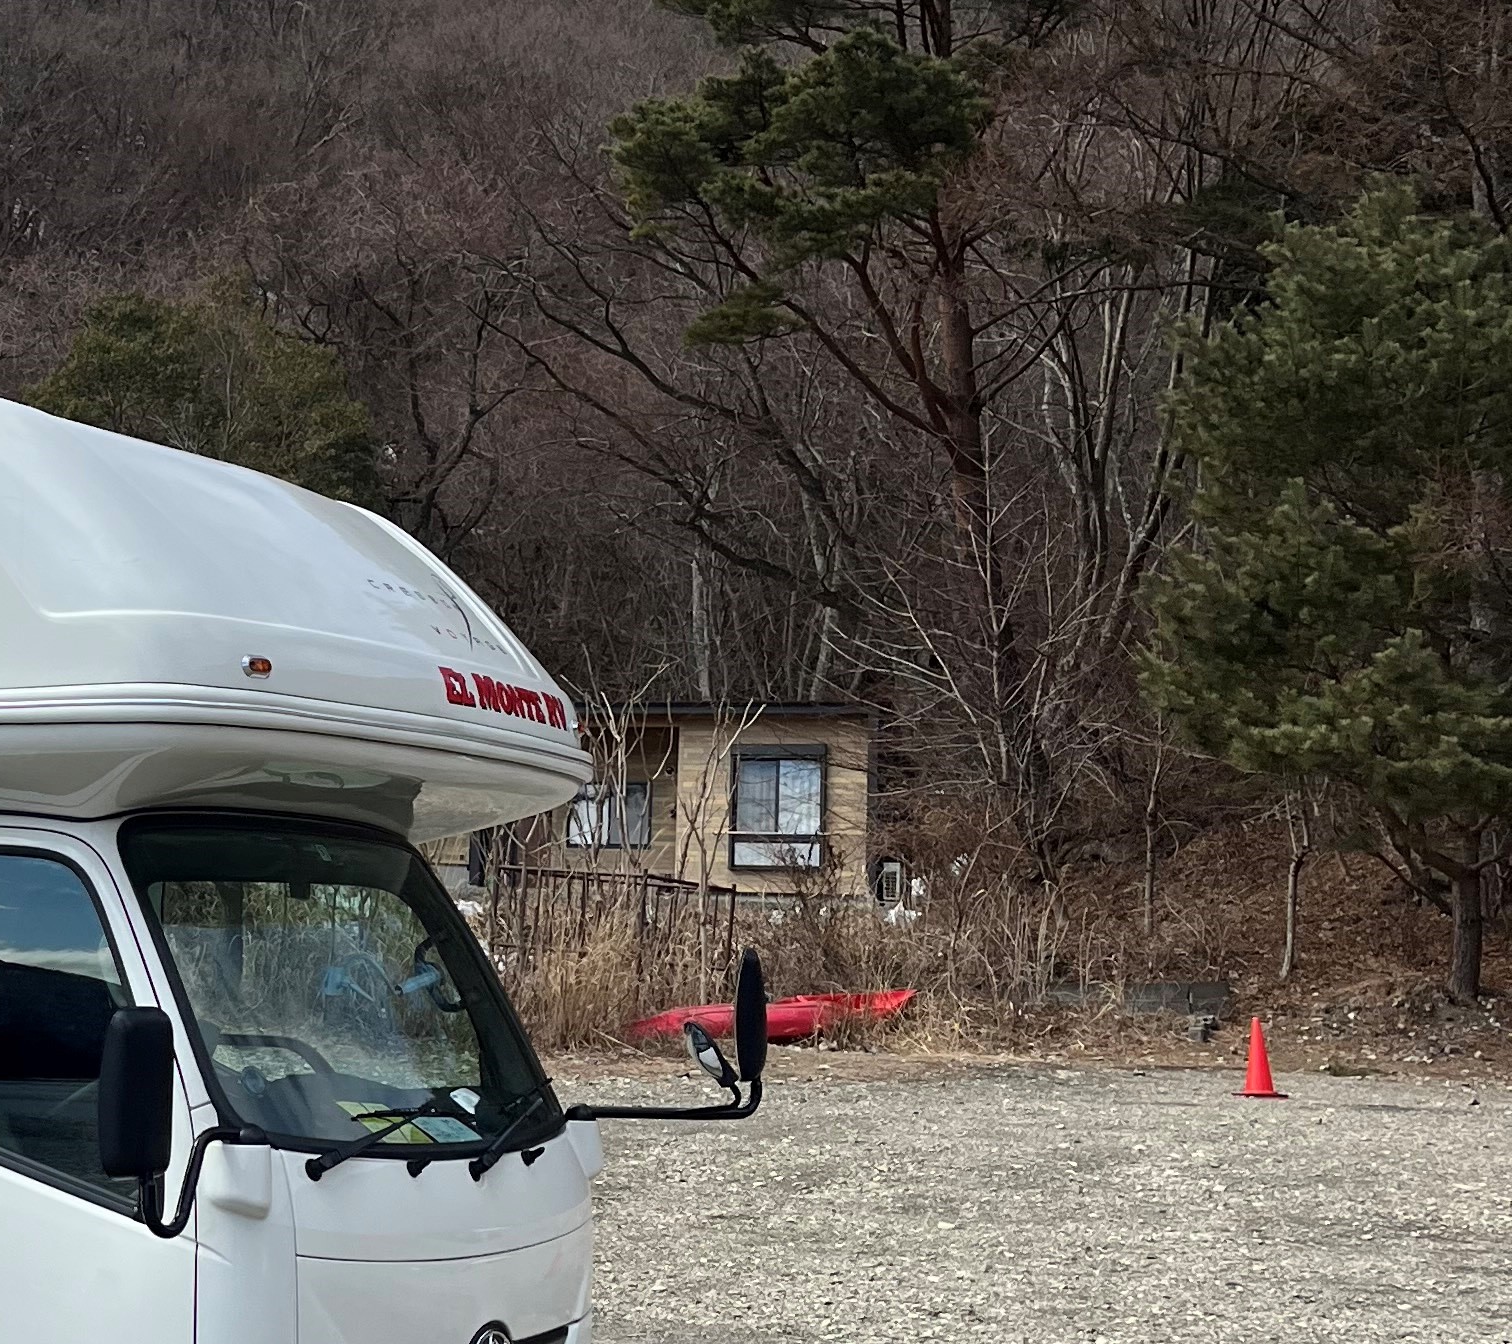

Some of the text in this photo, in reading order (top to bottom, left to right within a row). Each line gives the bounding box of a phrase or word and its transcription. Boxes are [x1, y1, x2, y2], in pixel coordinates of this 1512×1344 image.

[438, 665, 567, 731] EL MONTE RV
